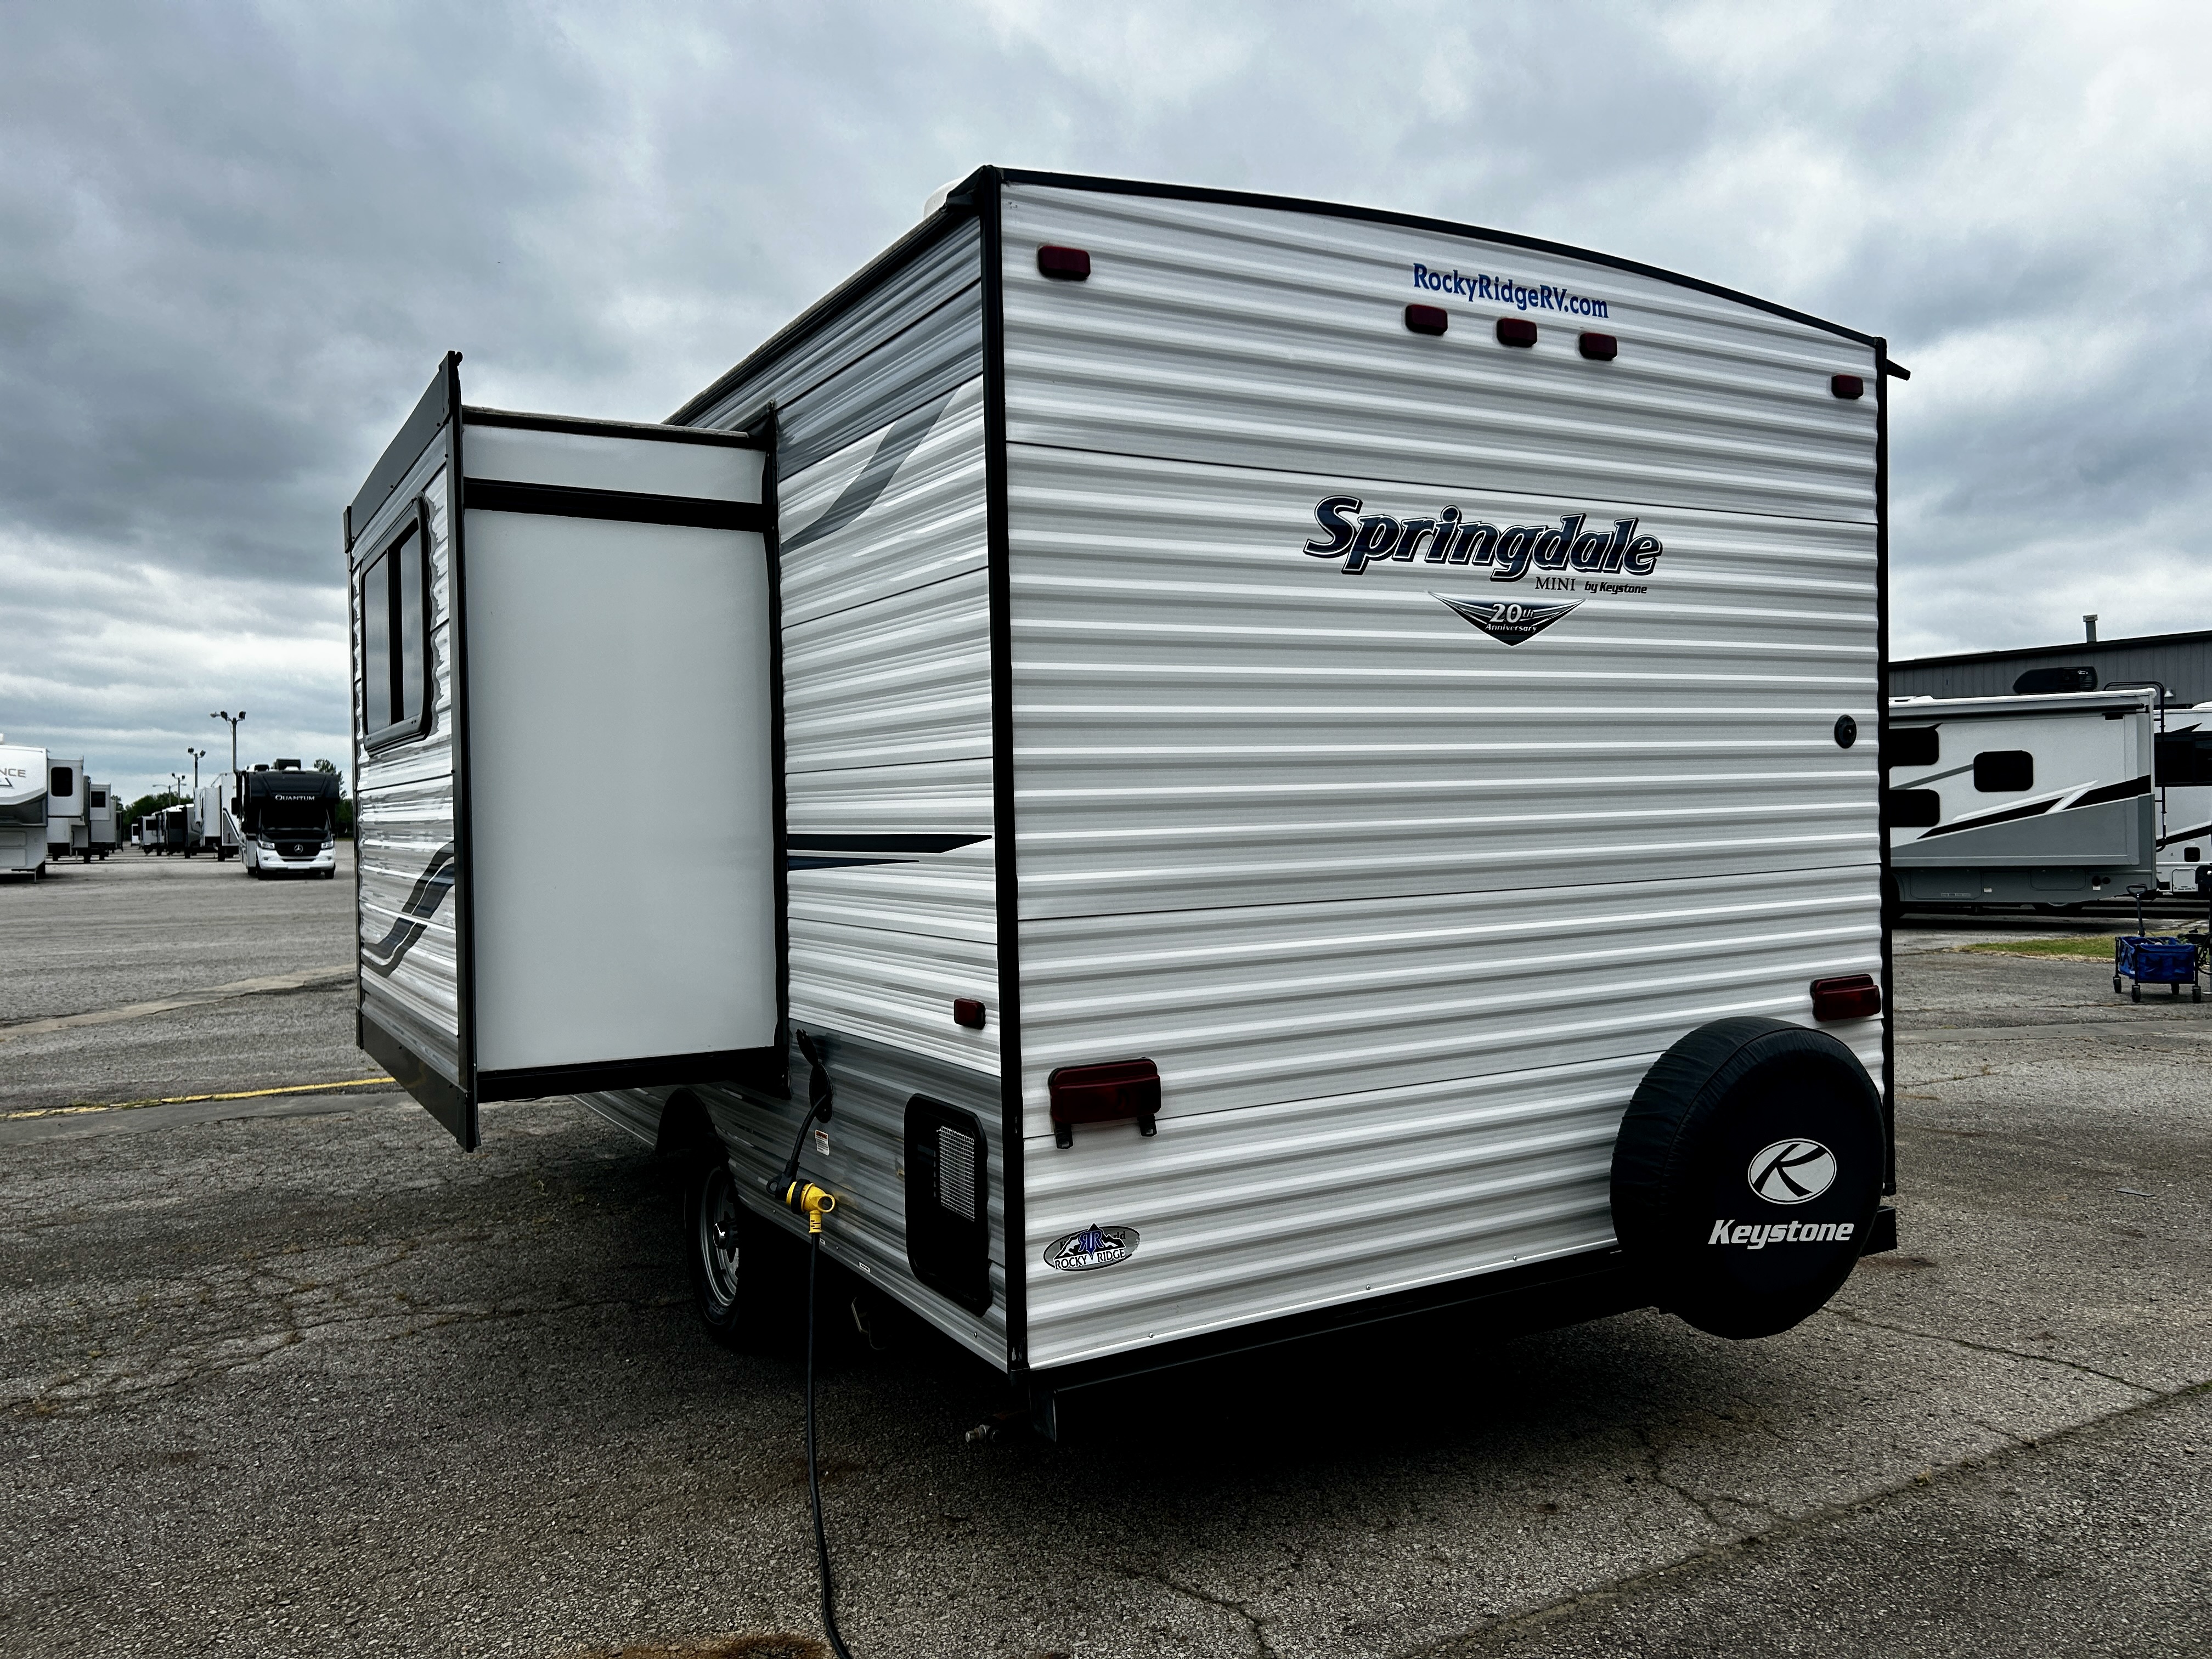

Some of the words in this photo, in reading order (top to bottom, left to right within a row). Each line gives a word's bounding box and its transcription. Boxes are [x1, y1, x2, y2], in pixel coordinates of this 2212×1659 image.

[1413, 263, 1609, 318] RockyRidgeRV.com
[1304, 495, 1663, 582] Springdale
[1535, 576, 1576, 591] MINI
[1584, 580, 1598, 594] by
[1599, 582, 1647, 595] Keystone
[1485, 623, 1537, 633] Anniversary
[1707, 1219, 1855, 1250] Keystone
[1055, 1254, 1087, 1271] ROCKY
[1097, 1248, 1126, 1263] RIDGE
